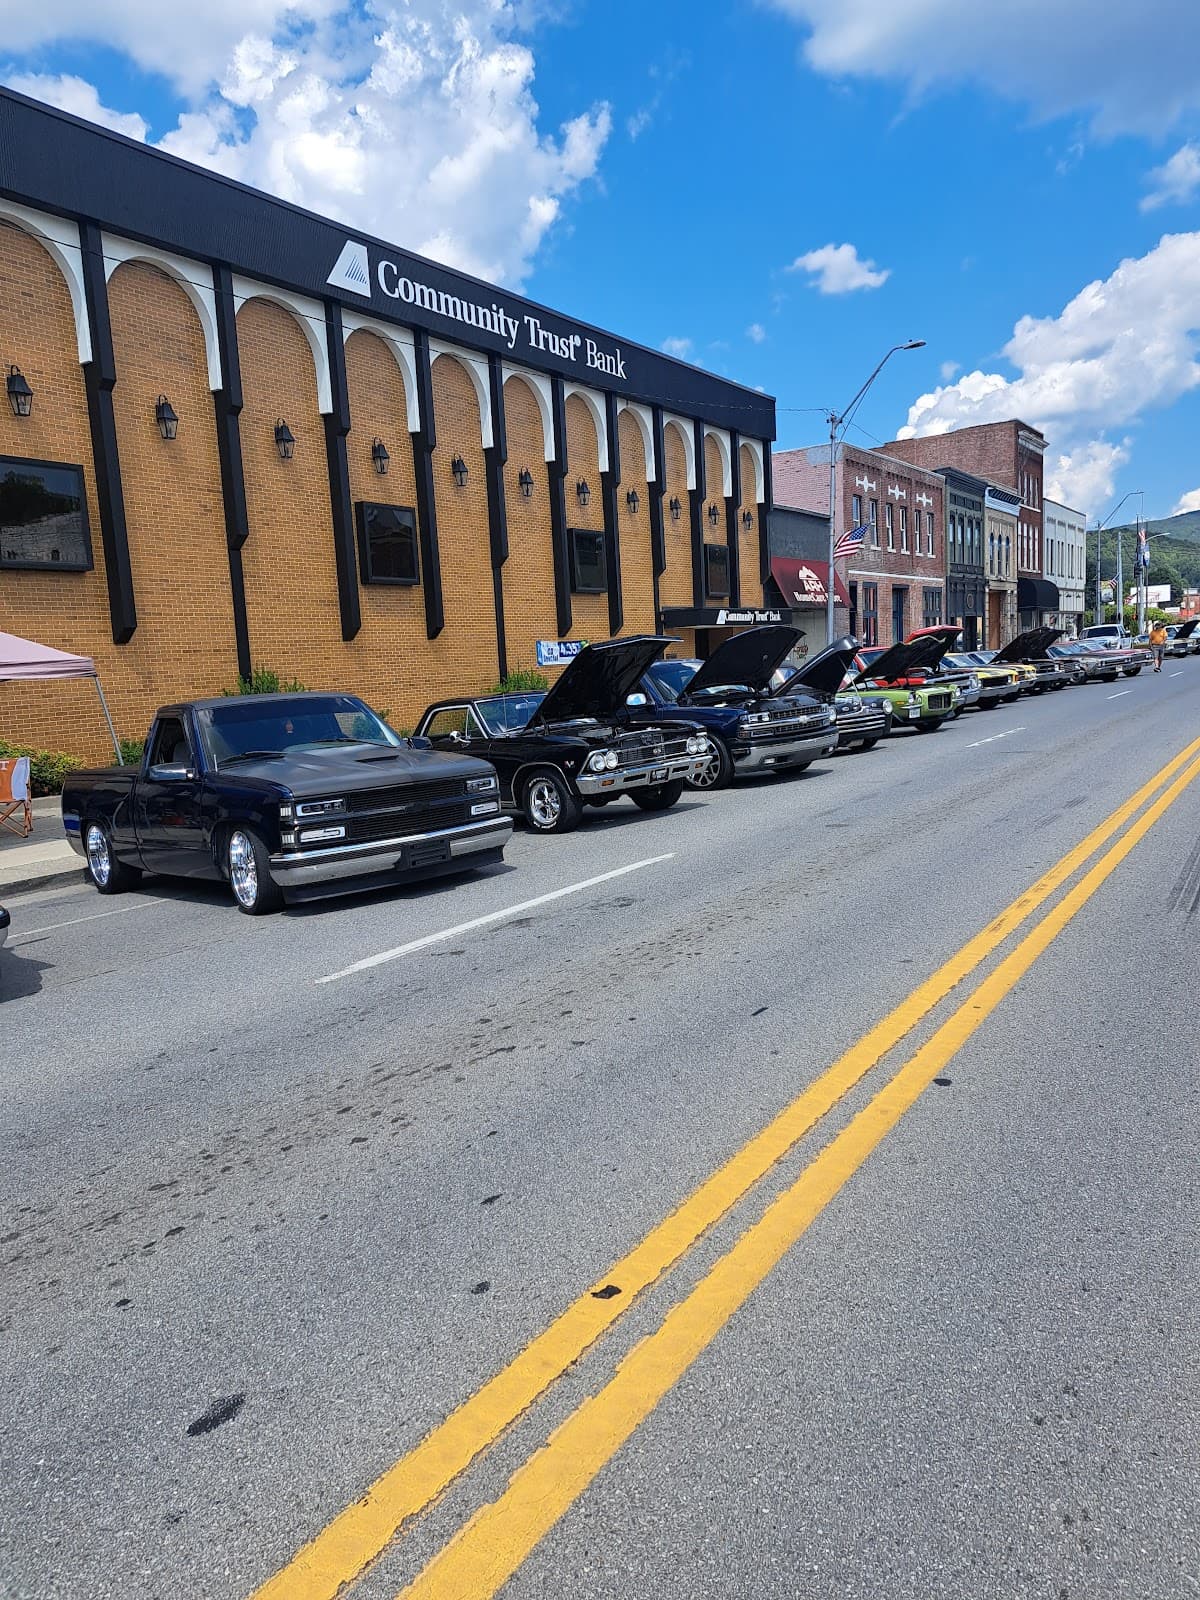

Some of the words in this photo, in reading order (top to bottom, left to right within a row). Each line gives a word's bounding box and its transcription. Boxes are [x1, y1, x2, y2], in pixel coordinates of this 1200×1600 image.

[377, 260, 519, 349] Community
[523, 315, 580, 362] Trust
[585, 338, 627, 380] Bank
[725, 610, 755, 624] Community
[754, 610, 769, 621] Trust
[769, 610, 782, 621] Bank
